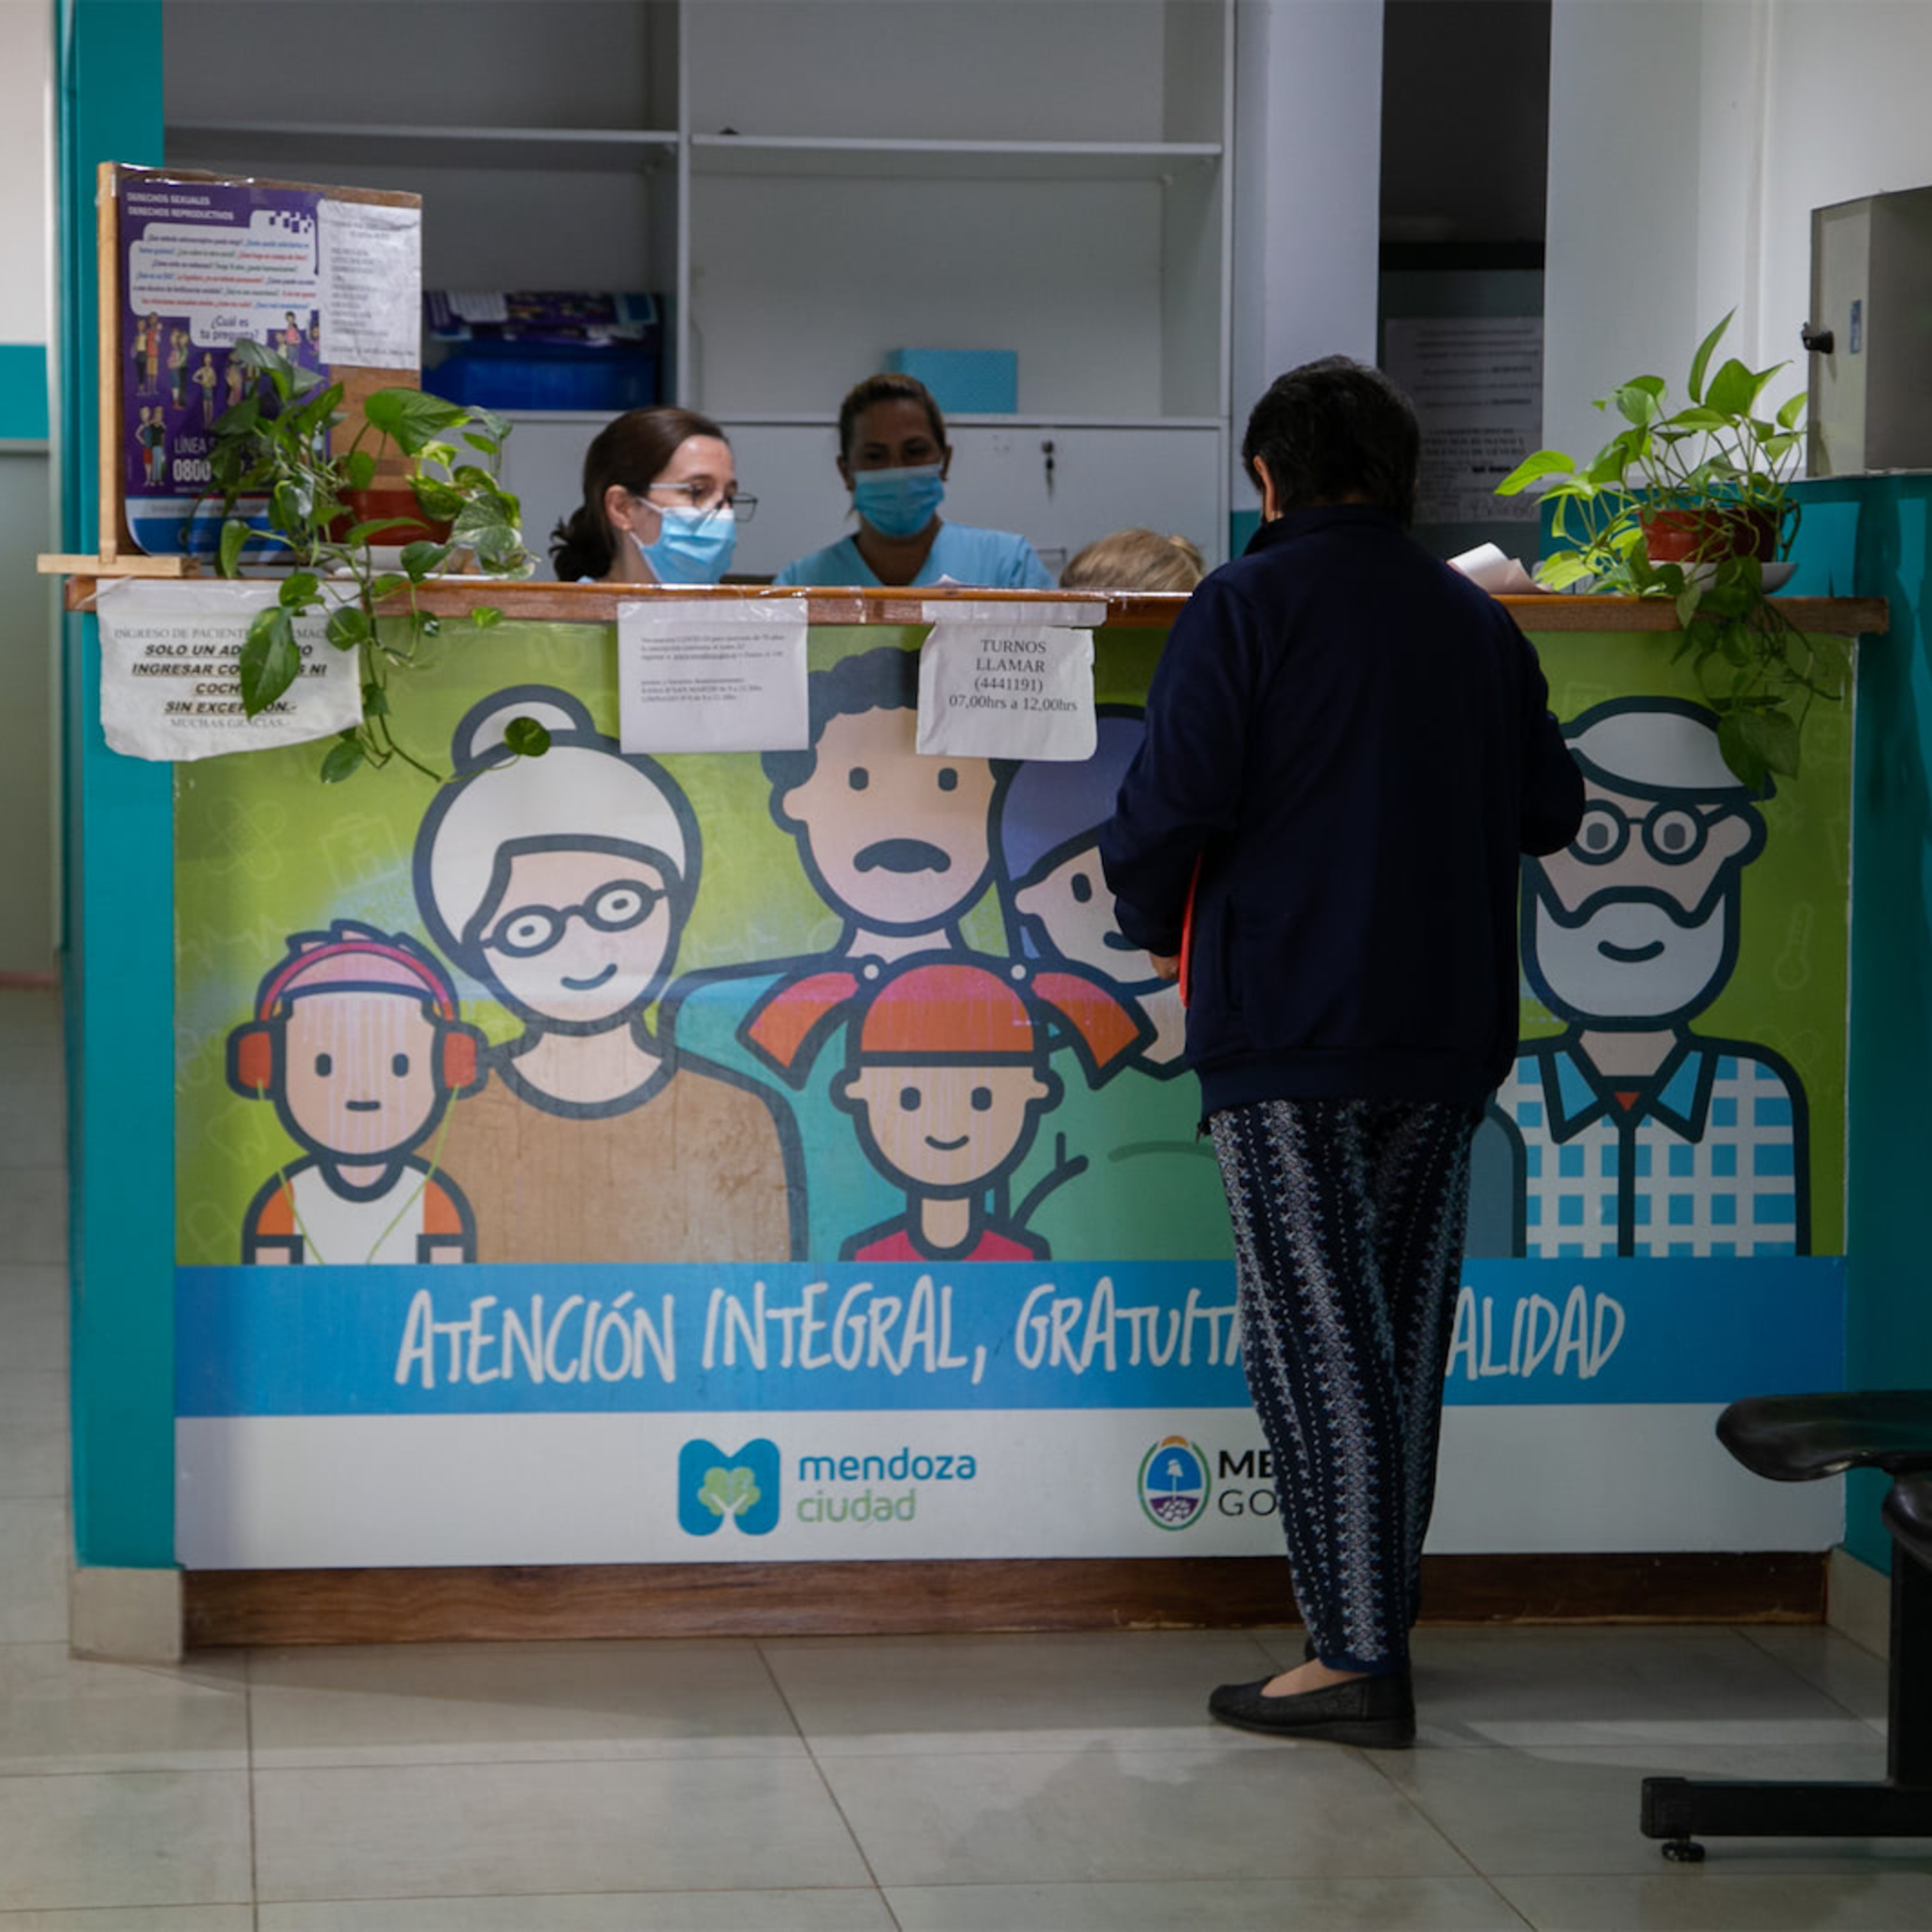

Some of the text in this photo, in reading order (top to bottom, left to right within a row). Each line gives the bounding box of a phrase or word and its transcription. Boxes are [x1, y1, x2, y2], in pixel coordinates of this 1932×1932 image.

[173, 459, 211, 482] 0800
[115, 628, 251, 639] INGRESO DE PACIENT
[145, 645, 187, 656] SOLO
[192, 645, 215, 656] UN
[981, 639, 1046, 654] TURNOS
[132, 663, 213, 676] INGRESAR
[218, 665, 241, 675] CO
[309, 664, 327, 676] NI
[976, 658, 1045, 673] LLAMAR
[195, 683, 241, 694] COCH
[974, 677, 1043, 692] (4441191)
[165, 701, 193, 712] SIN
[949, 694, 1077, 712] 07,00hrs a 12,00hrs
[171, 718, 223, 728] MUCHAS
[395, 1289, 675, 1389] ATENCIÓN
[701, 1275, 986, 1385] INTEGRAL,
[1445, 1285, 1625, 1380] ALIDAD
[799, 1446, 976, 1481] mendoza
[797, 1488, 916, 1522] ciudad
